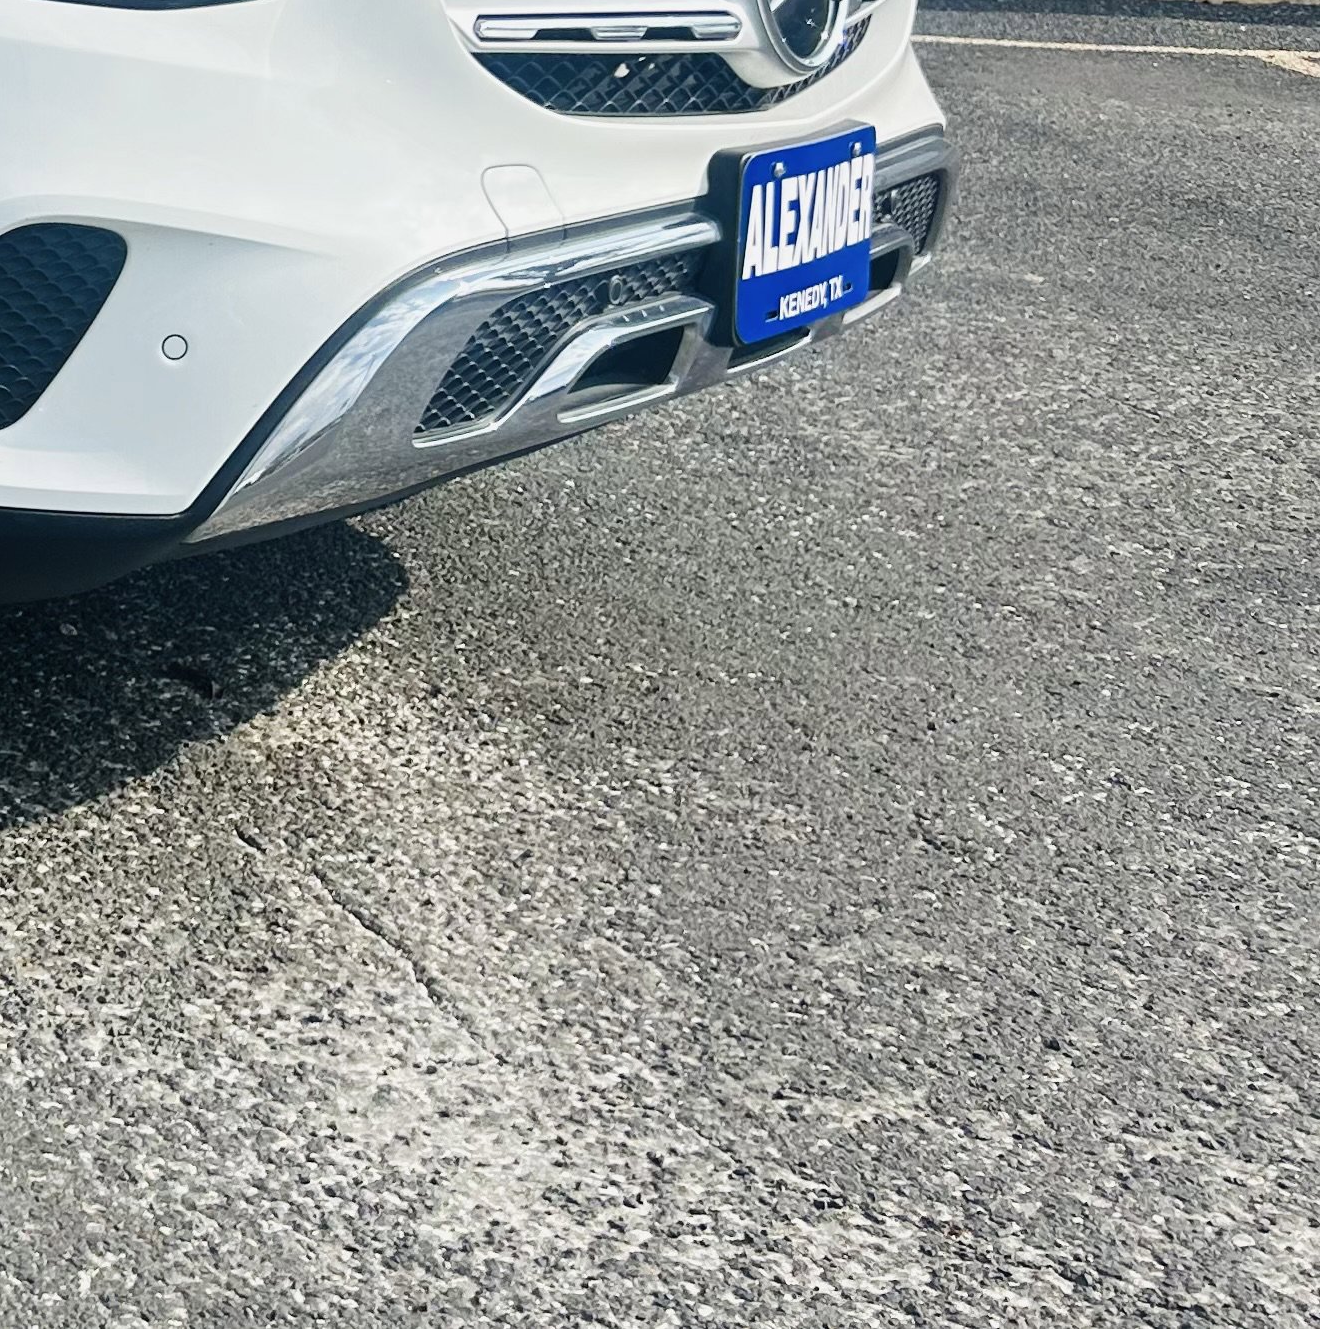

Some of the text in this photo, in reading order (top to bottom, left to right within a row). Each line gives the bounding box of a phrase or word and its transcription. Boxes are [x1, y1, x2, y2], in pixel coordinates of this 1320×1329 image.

[741, 152, 875, 281] ALEXANDER
[779, 274, 845, 321] KENEDY, TX
